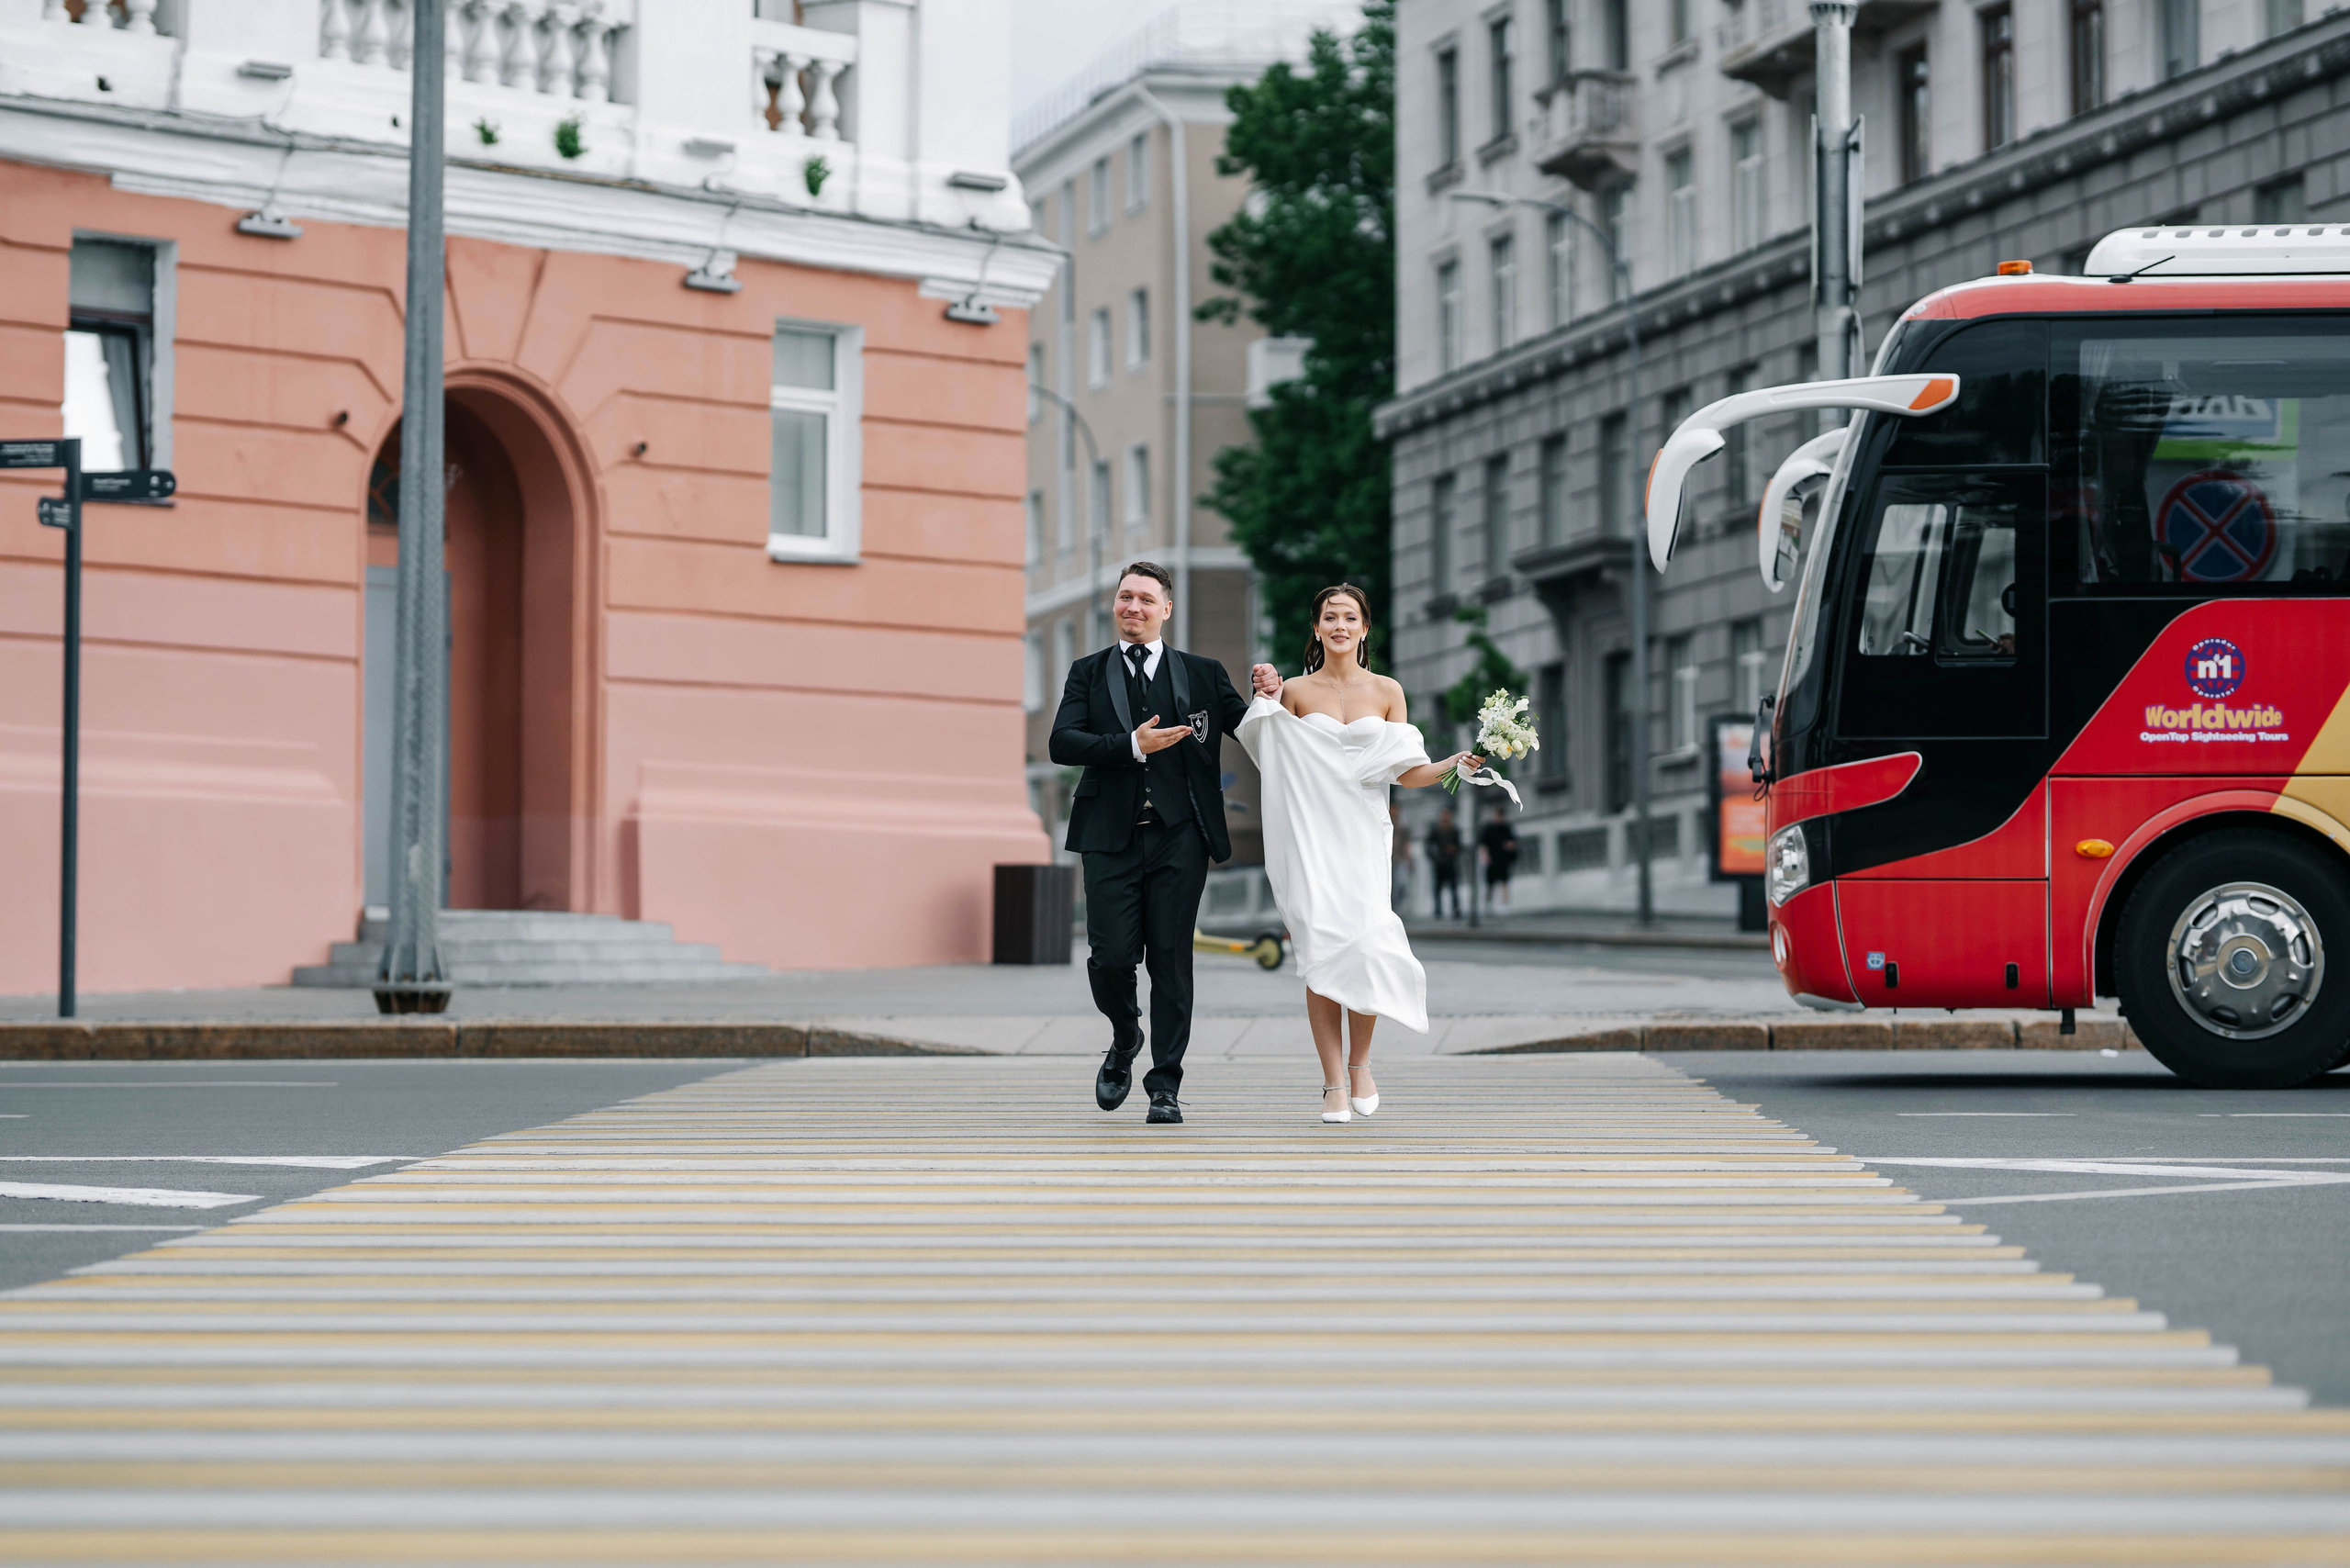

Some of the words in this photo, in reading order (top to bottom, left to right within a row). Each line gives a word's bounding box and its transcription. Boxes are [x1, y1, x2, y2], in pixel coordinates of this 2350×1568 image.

[2145, 703, 2283, 729] Worldwide
[2140, 732, 2189, 743] OpenTop
[2191, 732, 2256, 743] Sightseeing
[2257, 732, 2289, 742] Tours
